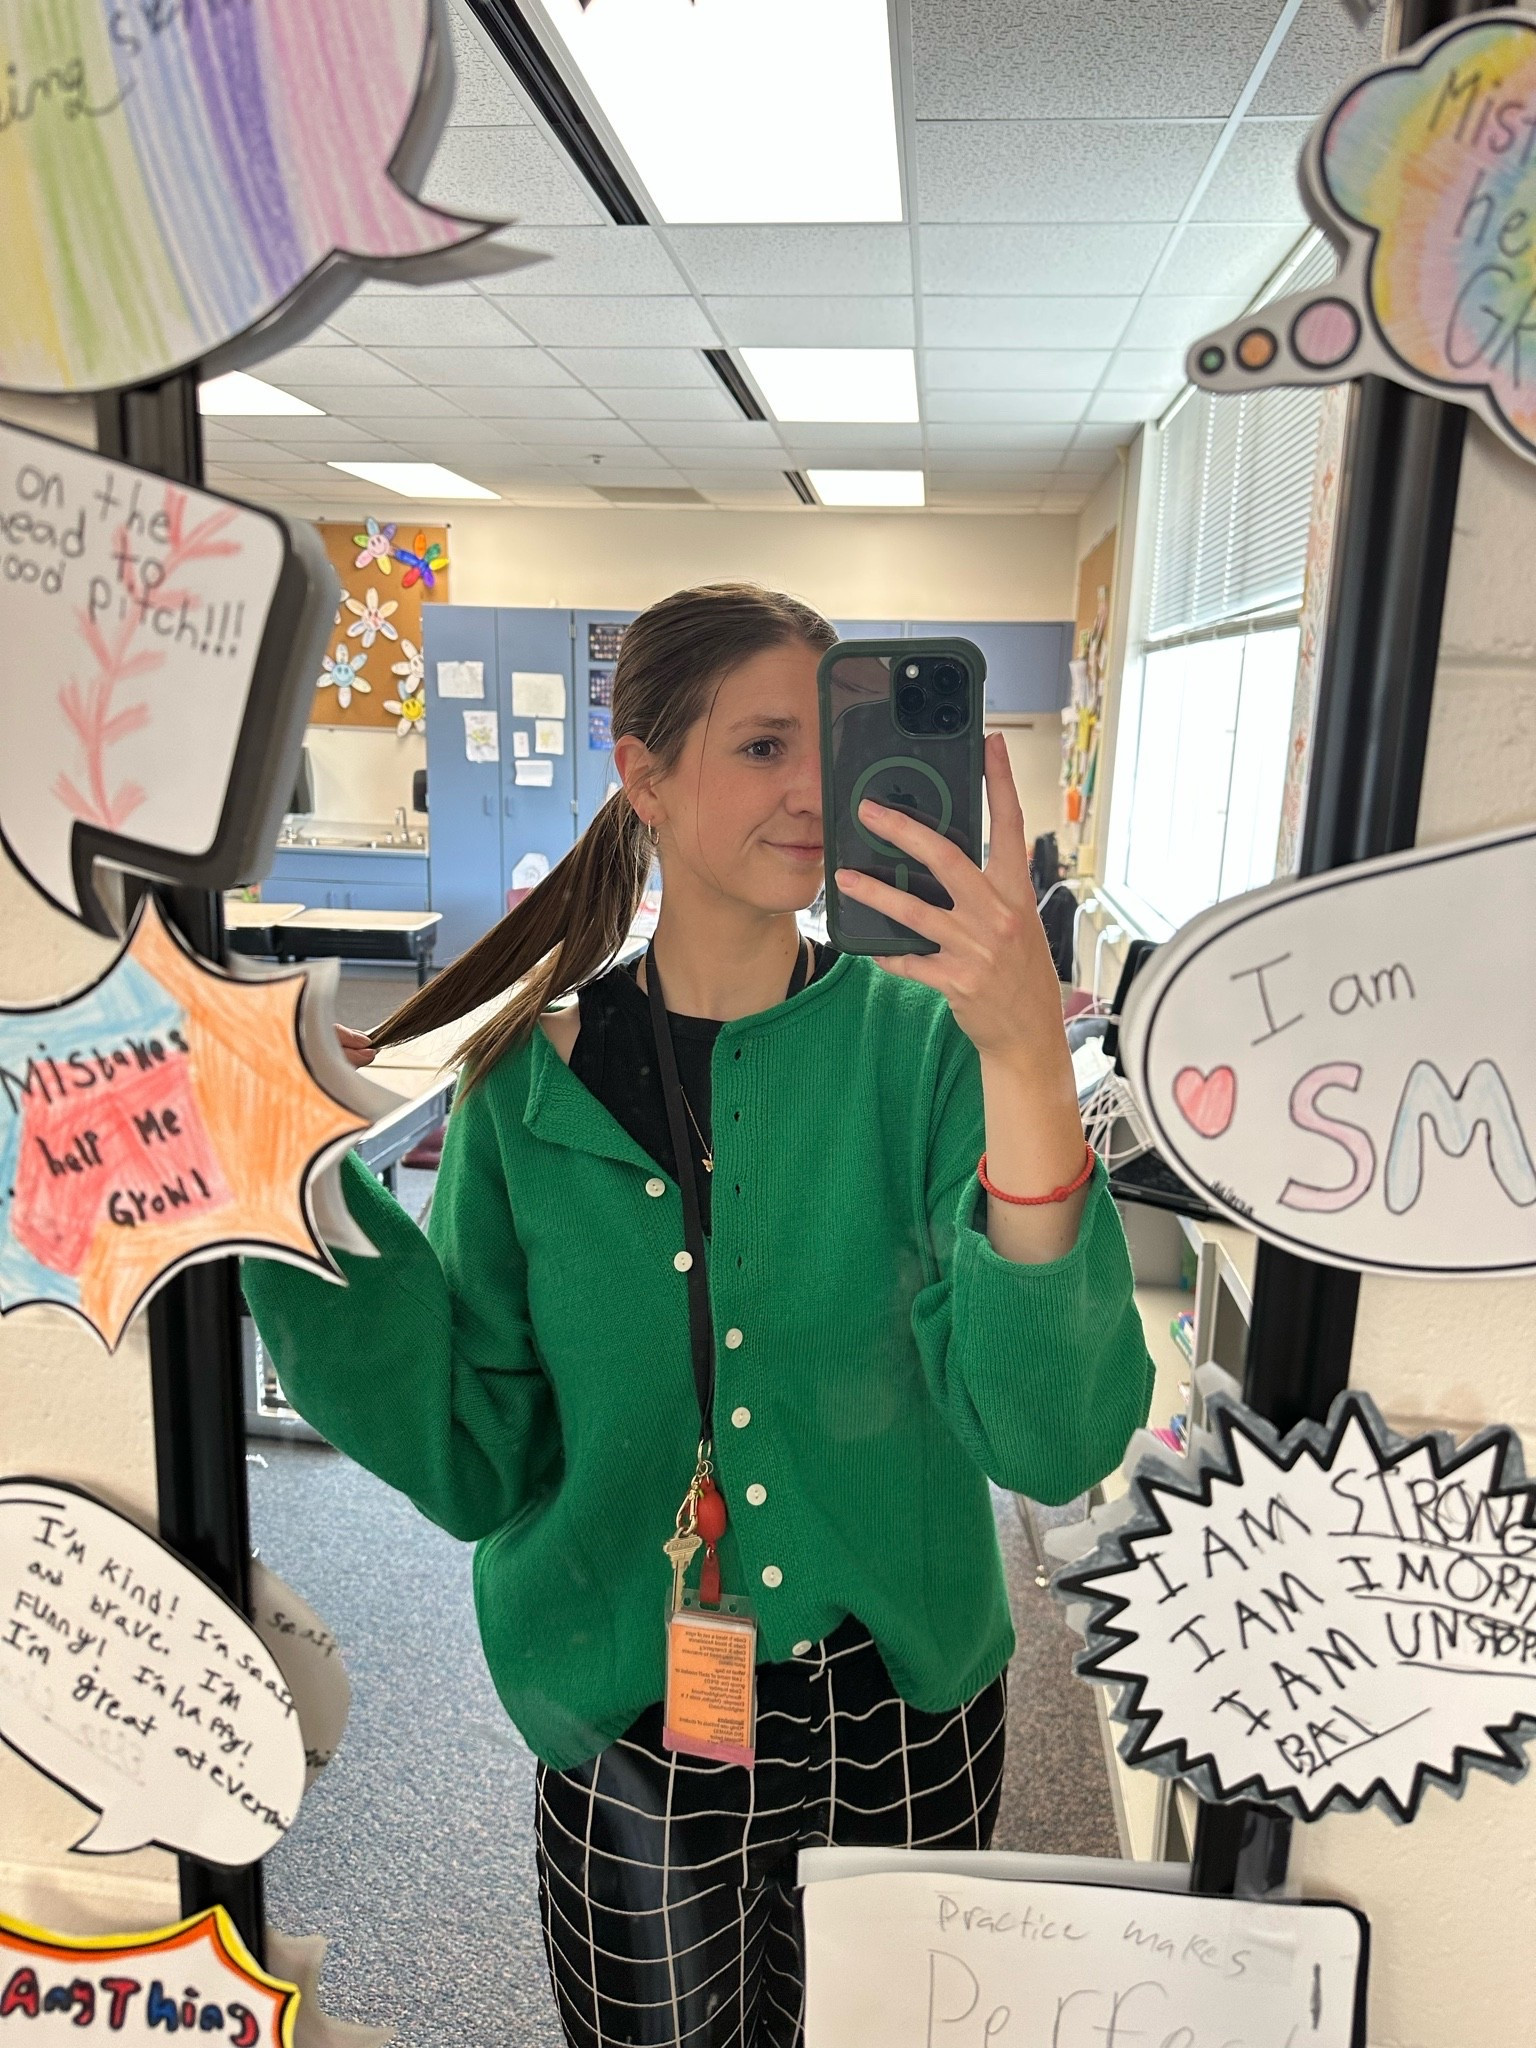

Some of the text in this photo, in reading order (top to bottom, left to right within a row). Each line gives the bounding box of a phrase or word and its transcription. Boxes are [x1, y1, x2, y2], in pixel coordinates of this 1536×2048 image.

[0, 57, 137, 132] ing
[15, 464, 171, 545] on the
[0, 552, 67, 595] ood
[1229, 952, 1417, 1047] I am
[1136, 1550, 1189, 1605] I
[1202, 1492, 1314, 1579] AM
[1169, 1551, 1536, 1674] I AM IMORT
[72, 1673, 158, 1737] great
[1210, 1689, 1271, 1737] I
[1270, 1627, 1379, 1711] AM
[936, 1891, 1251, 1977] Practice makes
